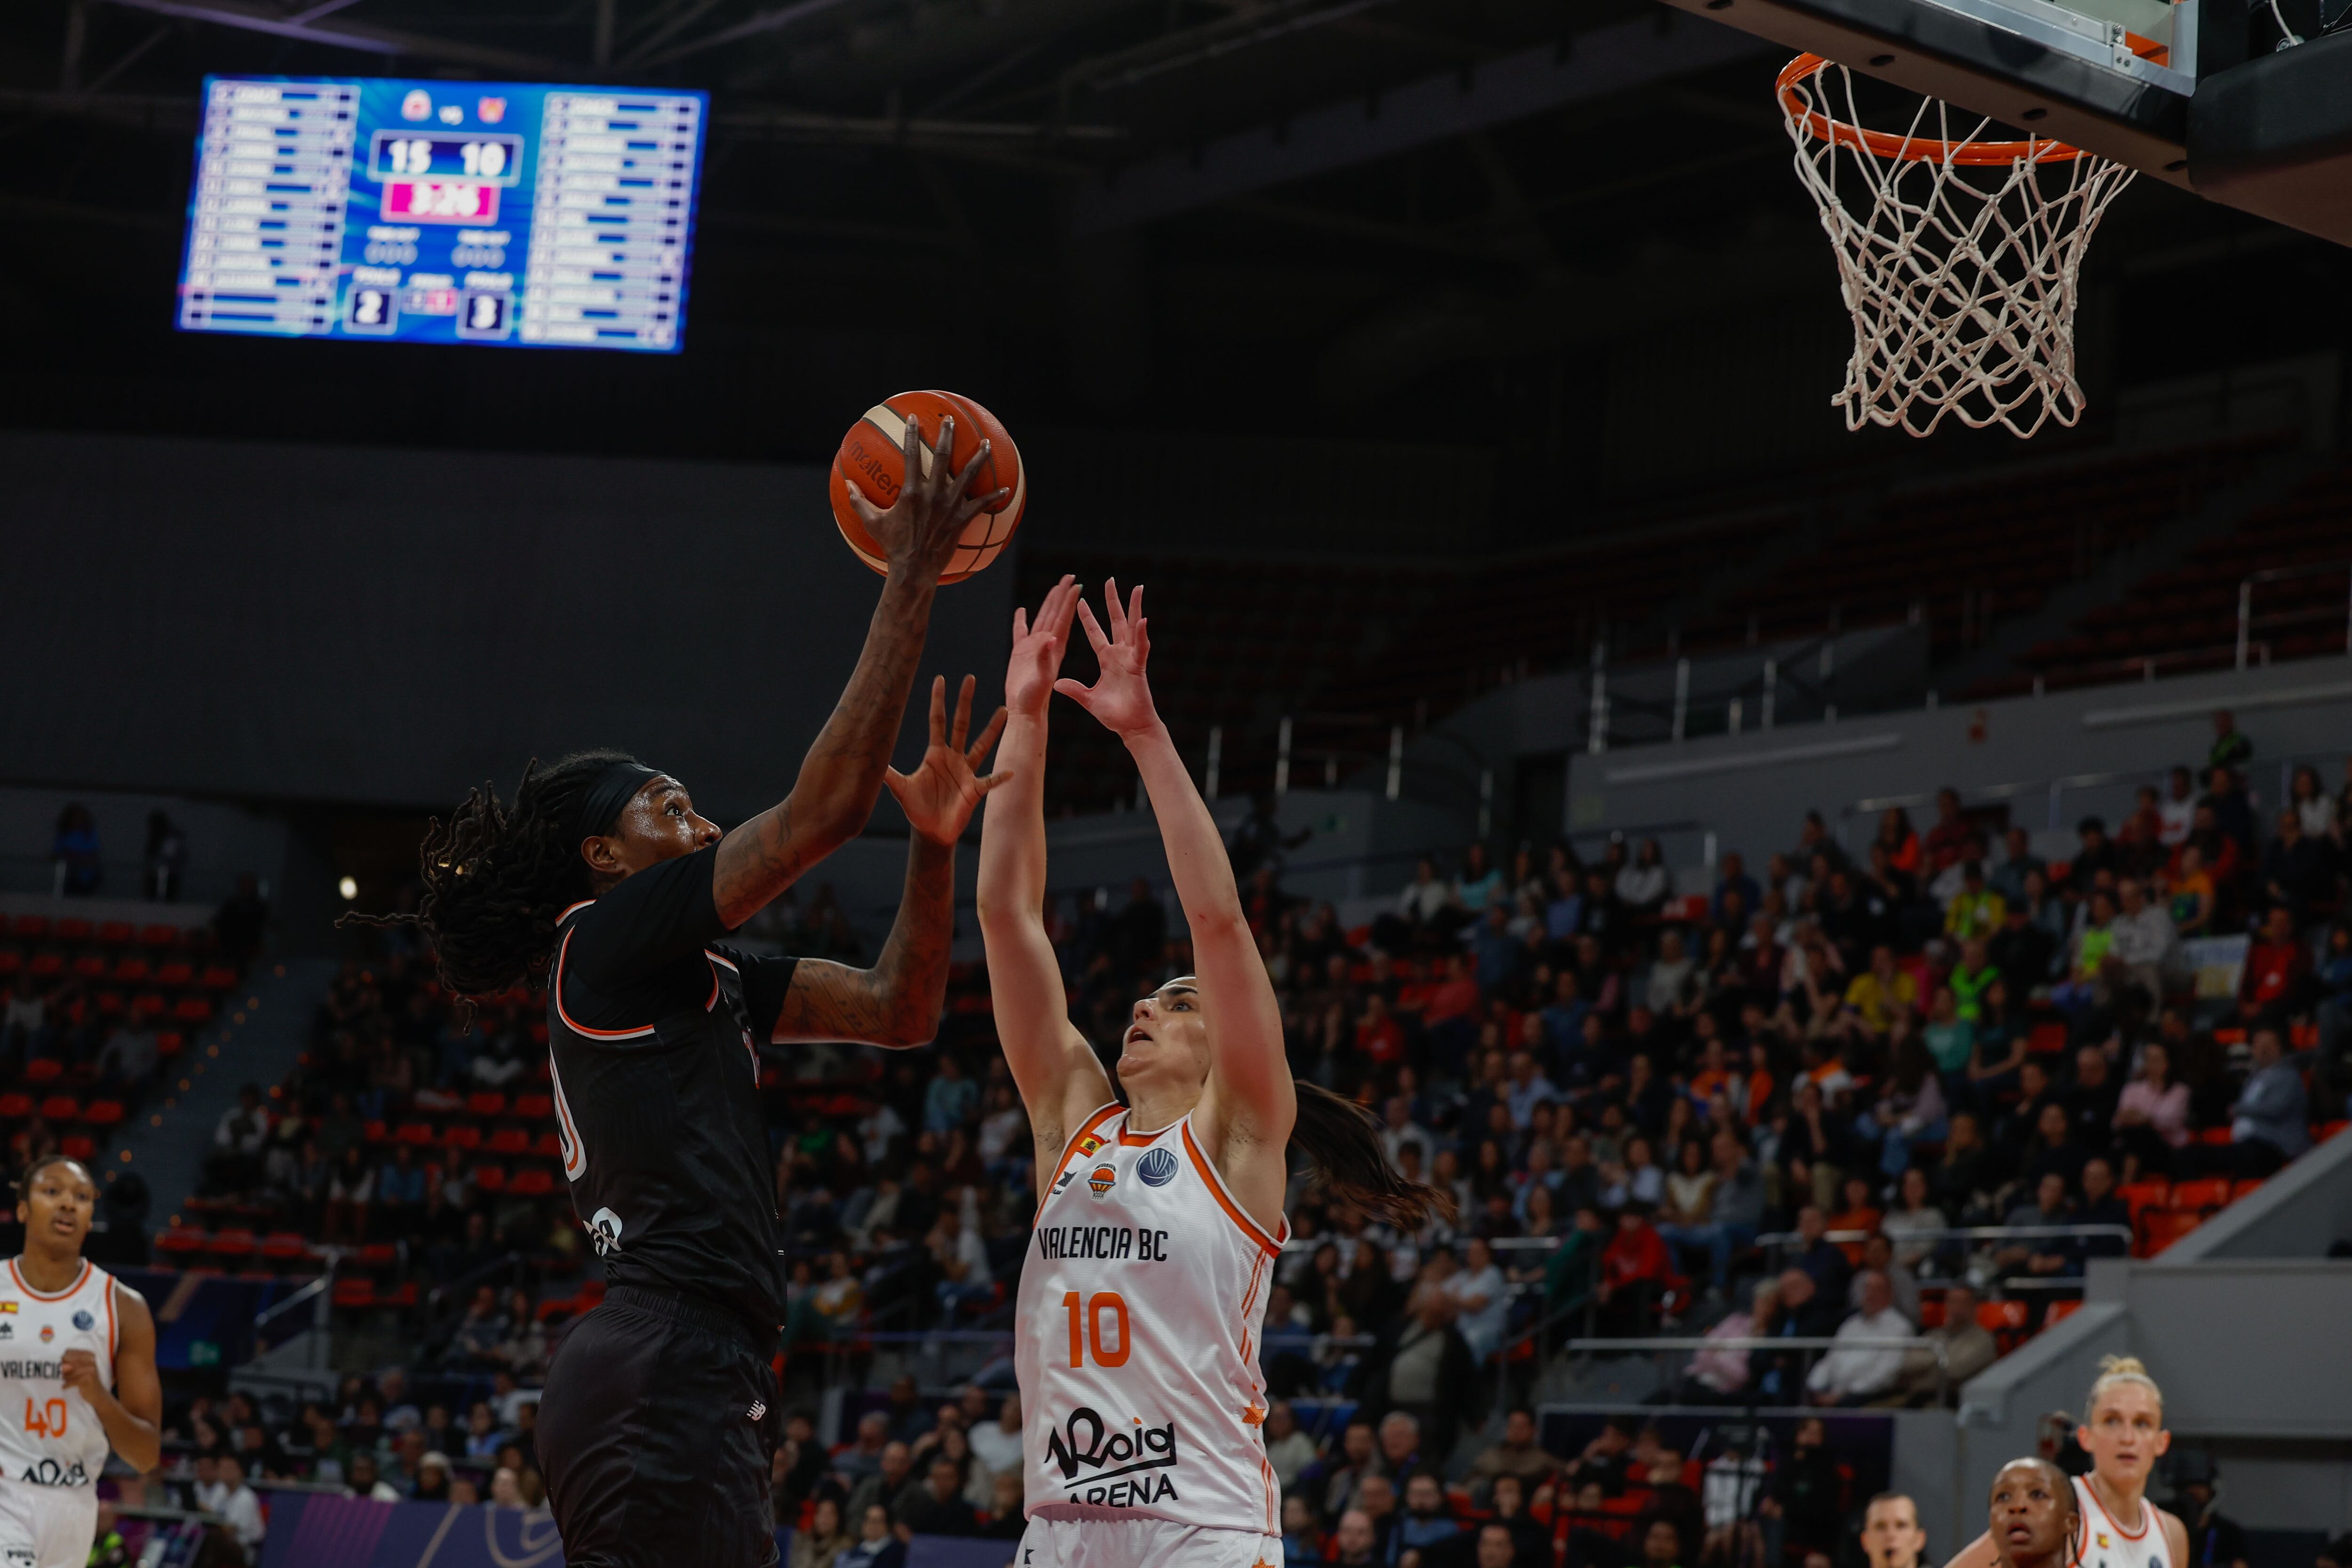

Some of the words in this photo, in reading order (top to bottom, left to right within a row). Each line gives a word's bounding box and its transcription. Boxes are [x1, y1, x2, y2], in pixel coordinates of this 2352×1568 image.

[388, 138, 432, 174] 15
[460, 142, 506, 177] 10
[355, 289, 383, 325] 2
[471, 294, 497, 329] 3
[1038, 1227, 1132, 1259] VALENCIA
[1137, 1228, 1168, 1262] BC
[1062, 1291, 1130, 1368] 10
[25, 1398, 66, 1439] 40
[1044, 1407, 1177, 1489] Roig
